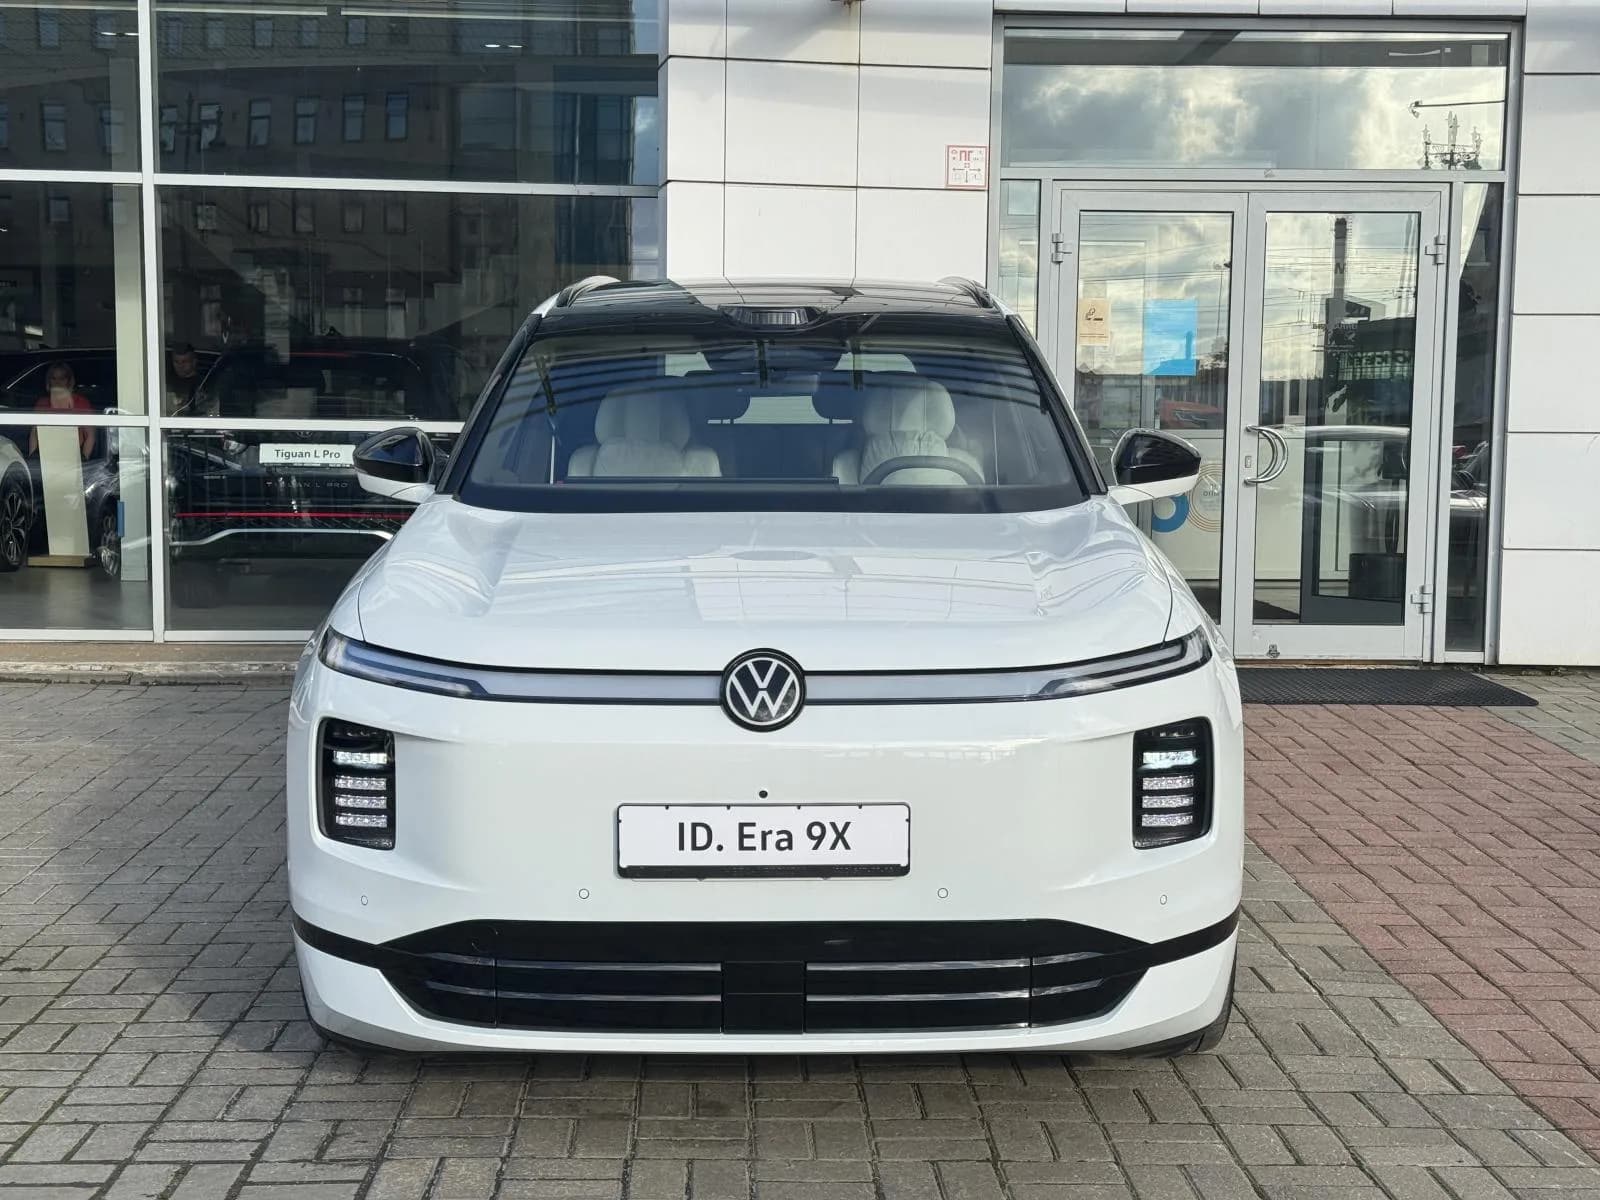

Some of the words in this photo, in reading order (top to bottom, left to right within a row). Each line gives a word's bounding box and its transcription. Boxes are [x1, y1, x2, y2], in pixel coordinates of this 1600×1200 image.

[274, 449, 311, 460] Tiguan
[314, 449, 320, 459] L
[323, 449, 341, 459] Pro
[677, 822, 724, 853] ID.
[738, 822, 794, 852] Era
[806, 821, 852, 852] 9X
